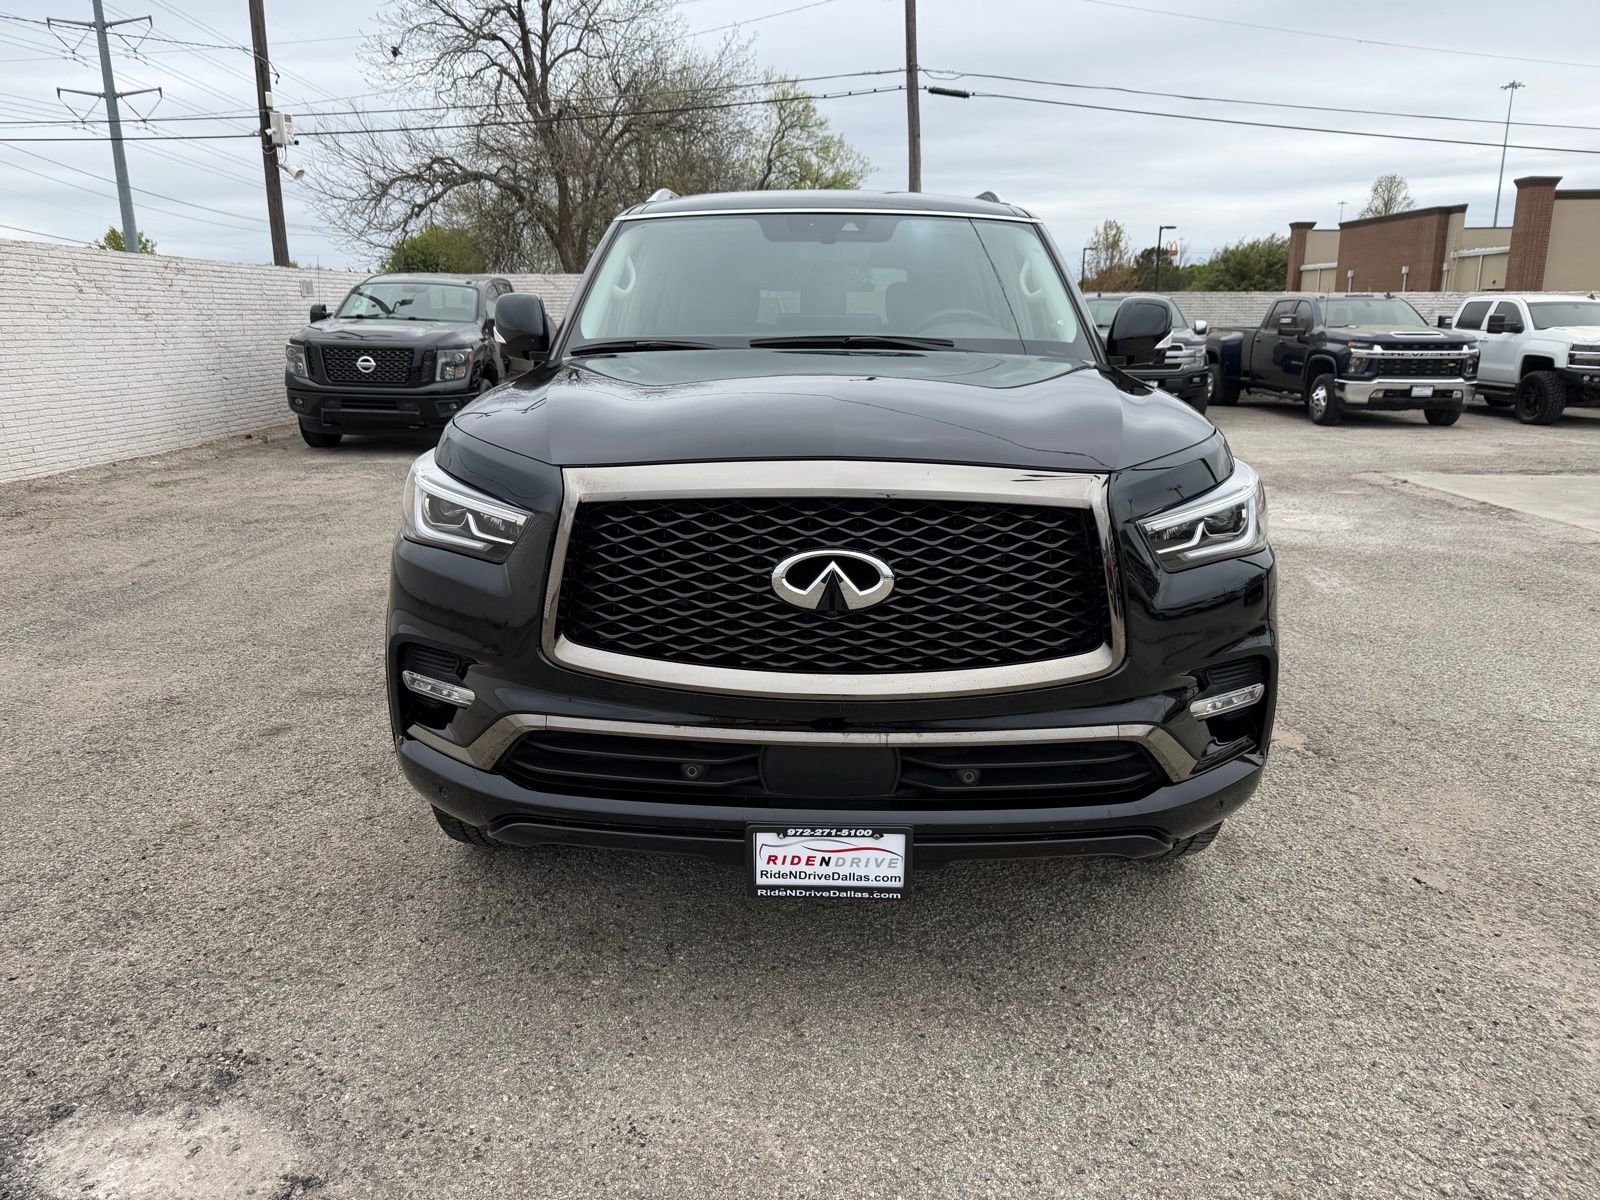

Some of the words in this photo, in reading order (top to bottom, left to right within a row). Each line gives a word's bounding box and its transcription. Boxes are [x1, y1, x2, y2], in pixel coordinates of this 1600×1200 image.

[787, 829, 872, 837] 972-271-5100
[760, 870, 901, 883] RideNDriveDallas.com
[757, 889, 901, 899] RideNDriveDallas.com
